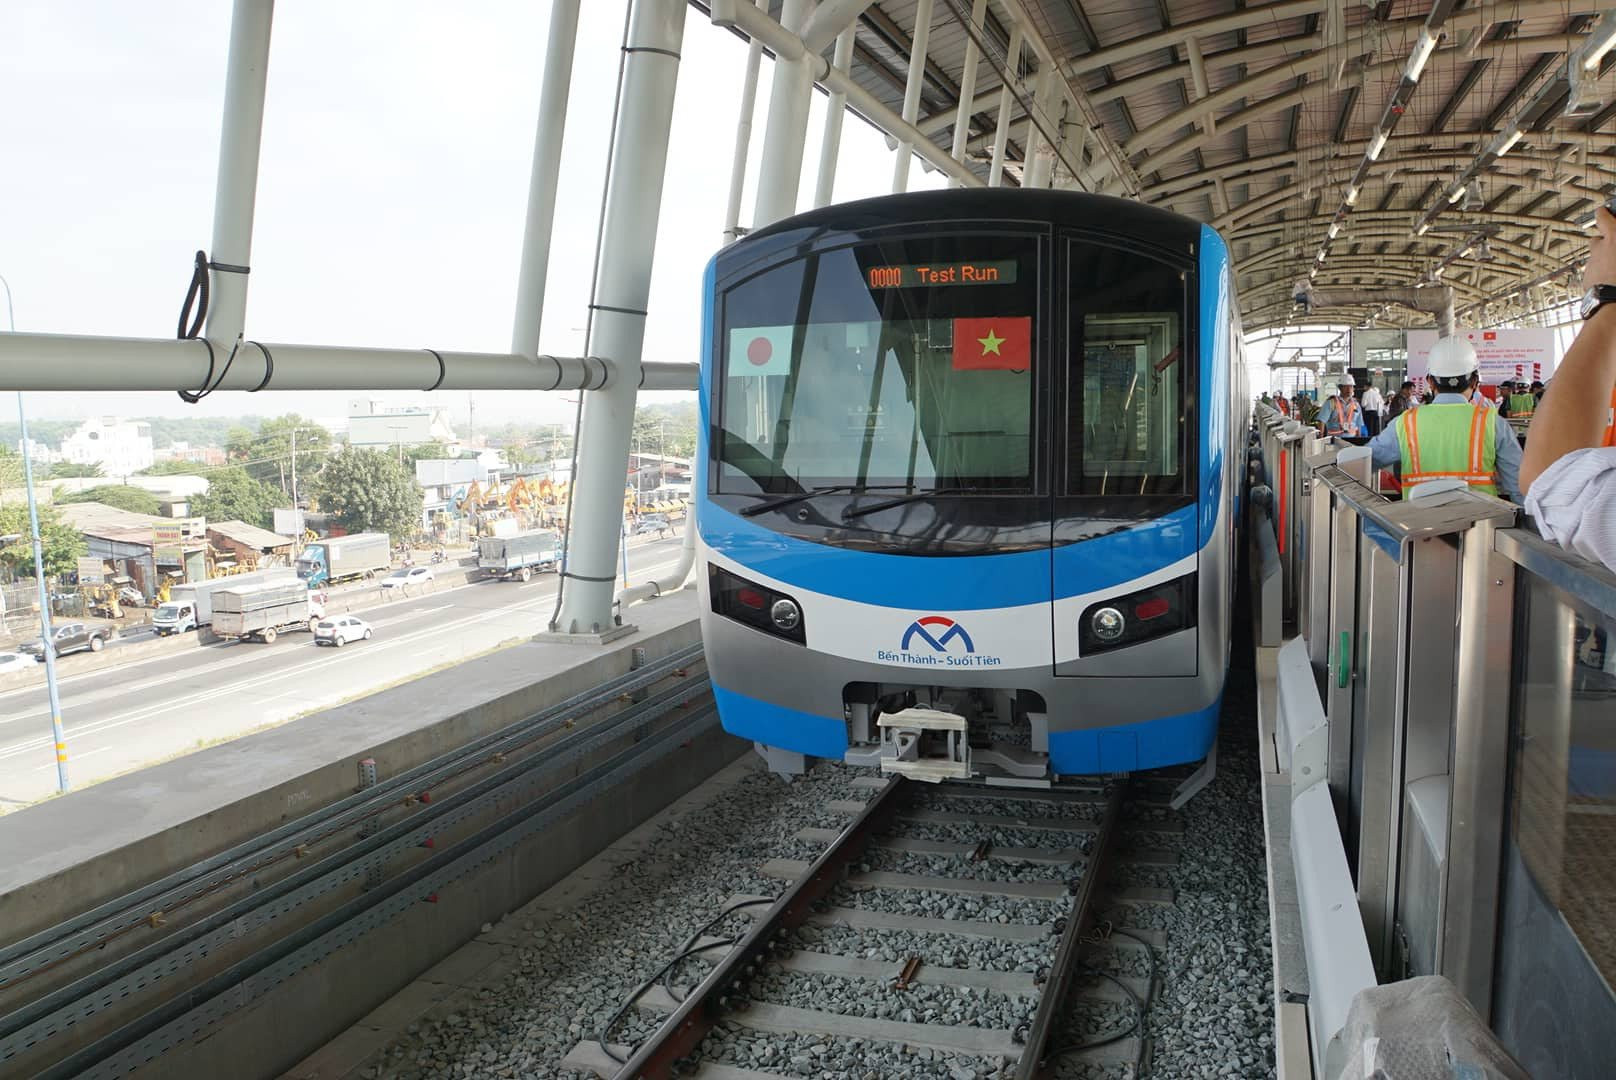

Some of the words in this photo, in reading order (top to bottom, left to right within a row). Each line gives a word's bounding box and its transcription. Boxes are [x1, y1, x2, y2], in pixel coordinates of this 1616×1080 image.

[917, 267, 955, 283] Test
[961, 265, 997, 281] Run
[878, 650, 899, 663] Bến
[900, 653, 937, 665] Thành
[946, 655, 973, 666] Suối
[976, 655, 1001, 666] Tiên
